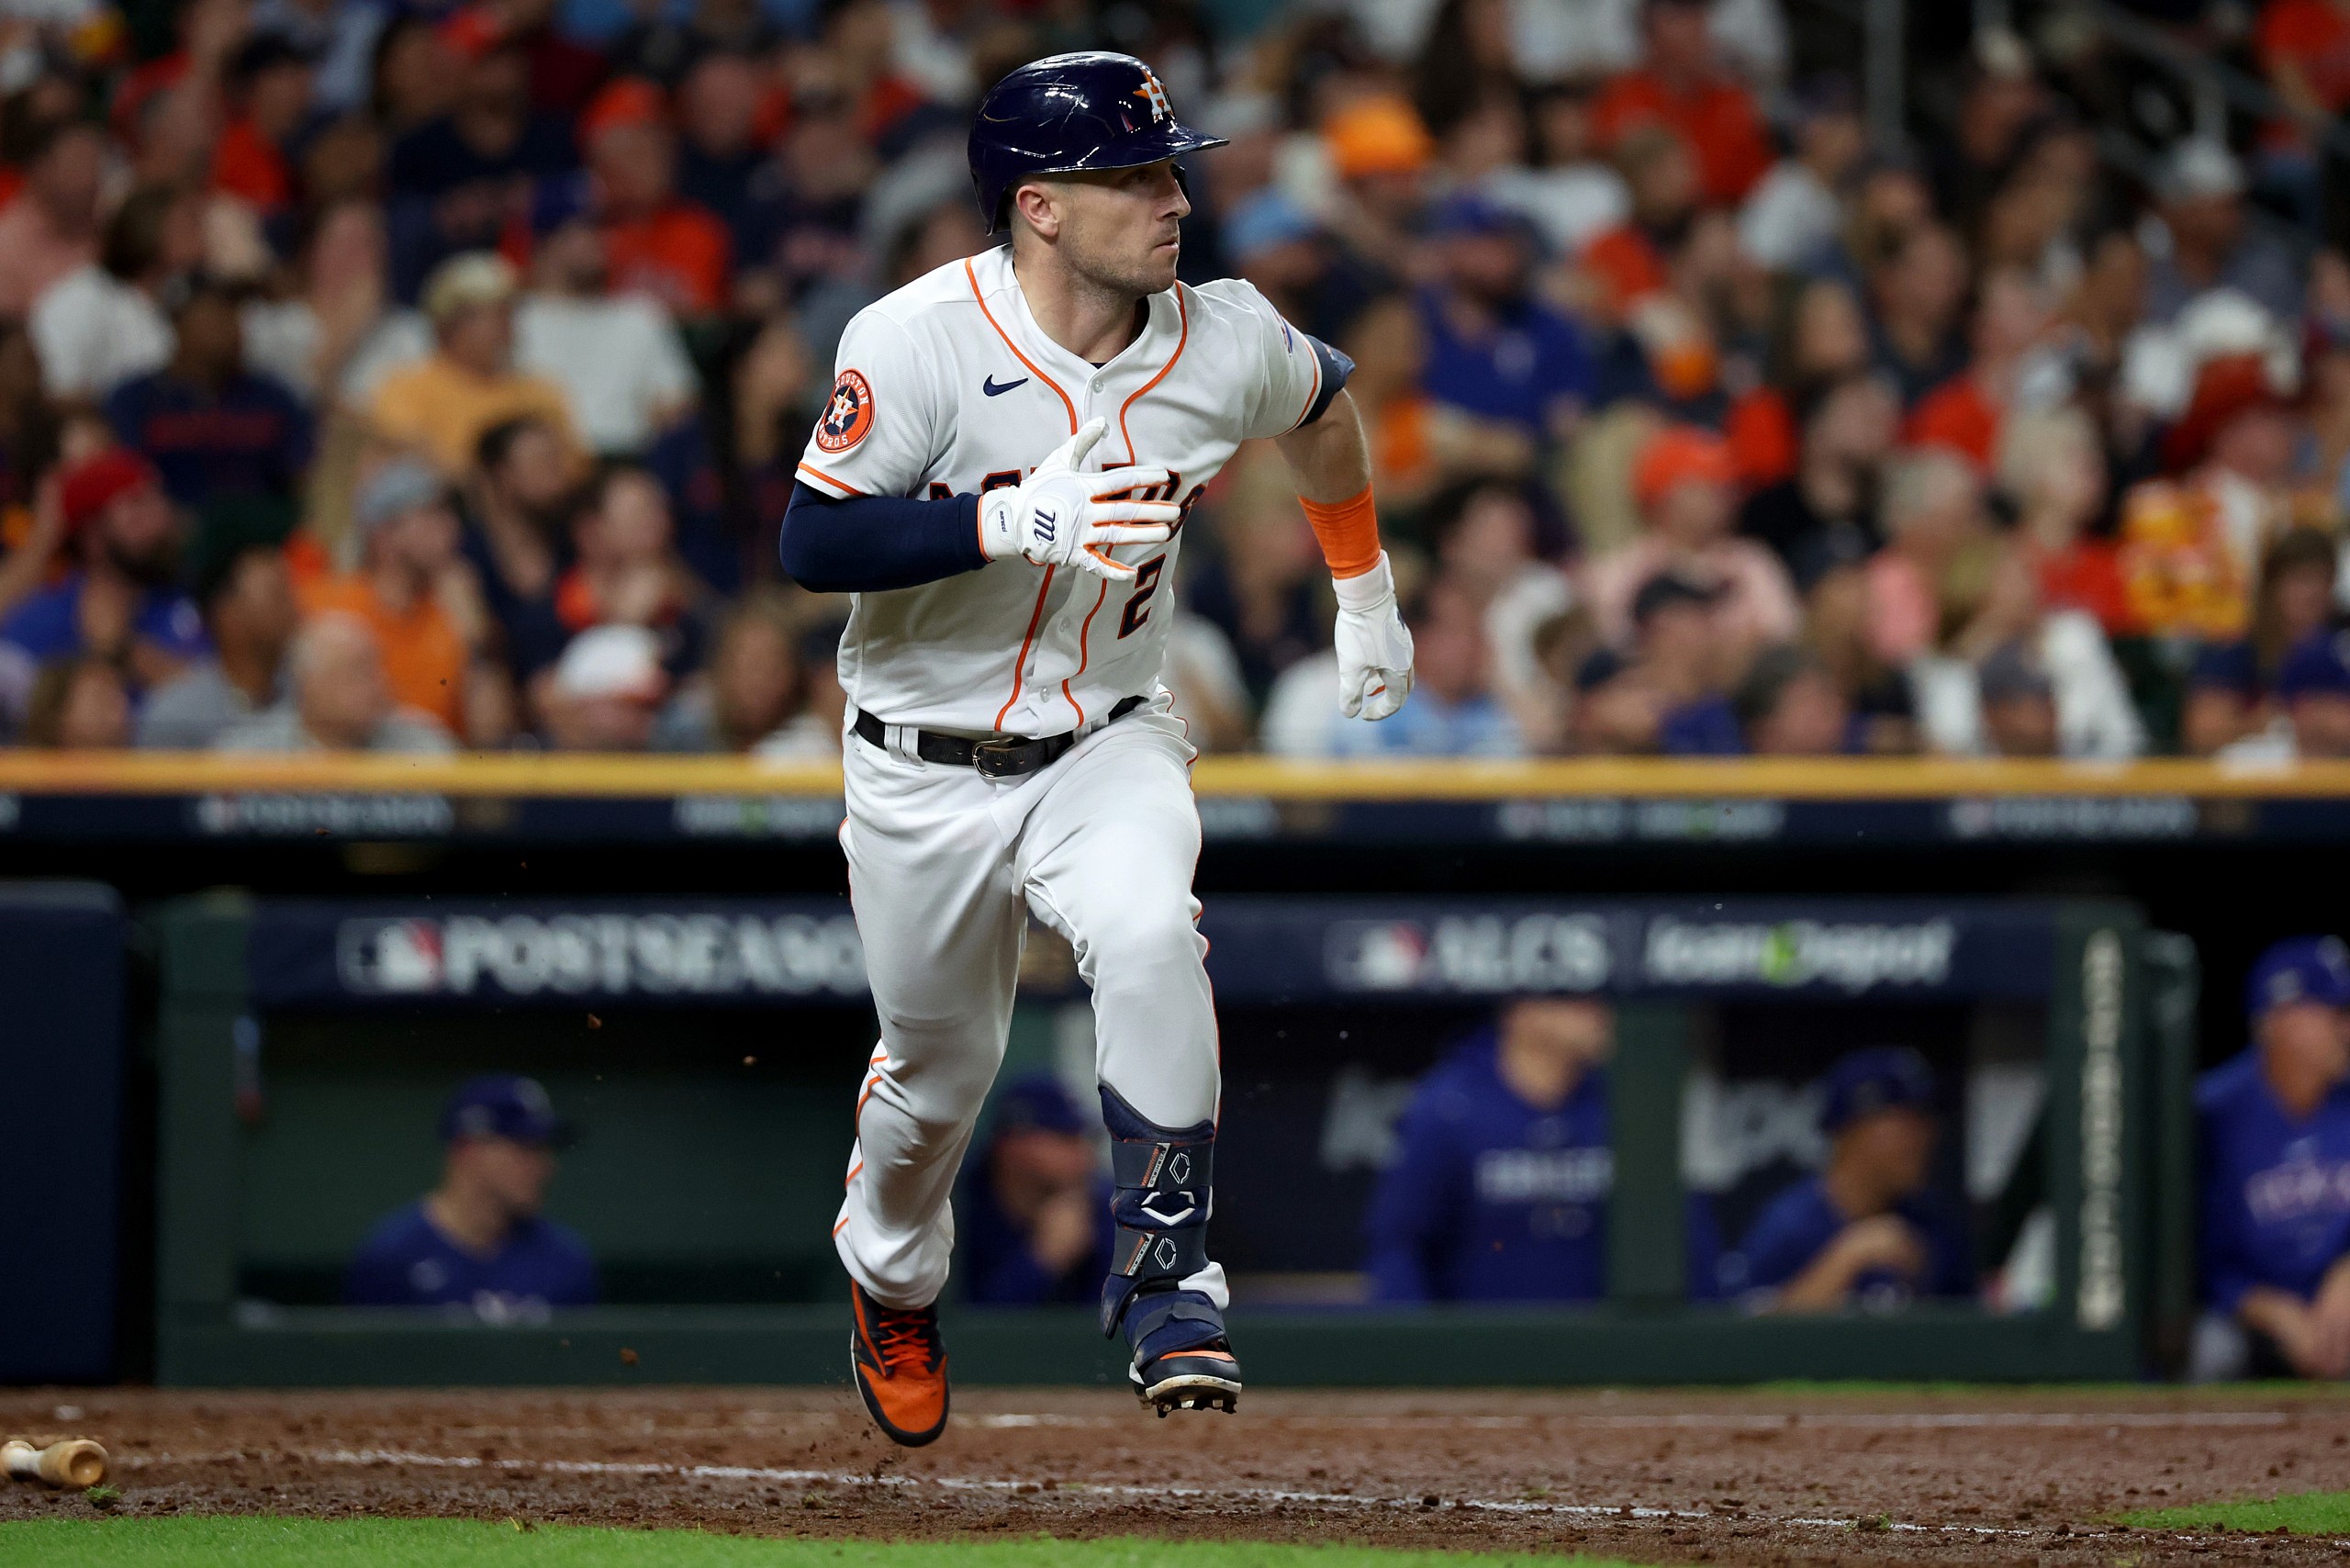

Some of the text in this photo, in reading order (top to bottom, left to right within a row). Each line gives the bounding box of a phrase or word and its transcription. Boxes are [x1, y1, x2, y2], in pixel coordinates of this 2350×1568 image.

[834, 373, 870, 405] HOUSTON
[818, 423, 848, 447] ASTROS
[1117, 553, 1167, 641] 2
[446, 914, 872, 995] POSTSEASO
